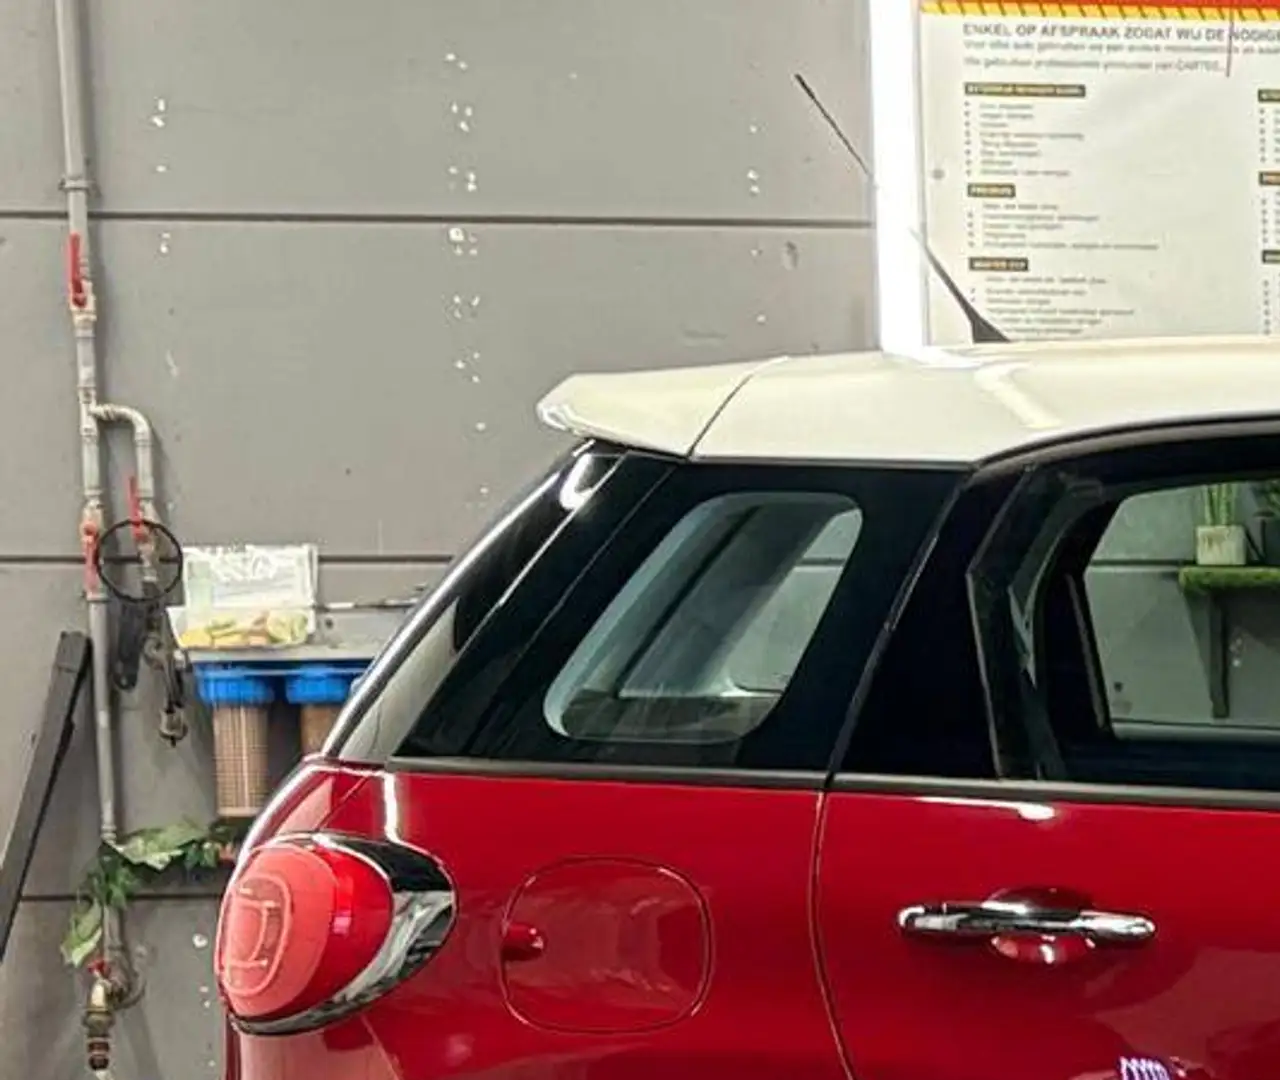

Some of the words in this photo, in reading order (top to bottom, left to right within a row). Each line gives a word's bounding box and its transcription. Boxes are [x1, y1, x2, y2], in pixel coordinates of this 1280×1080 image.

[964, 23, 1011, 37] ENKEL
[1015, 24, 1037, 37] OP
[1040, 24, 1120, 39] AFSPRAAK
[1123, 26, 1172, 40] ZODAT
[1205, 28, 1226, 42] DE
